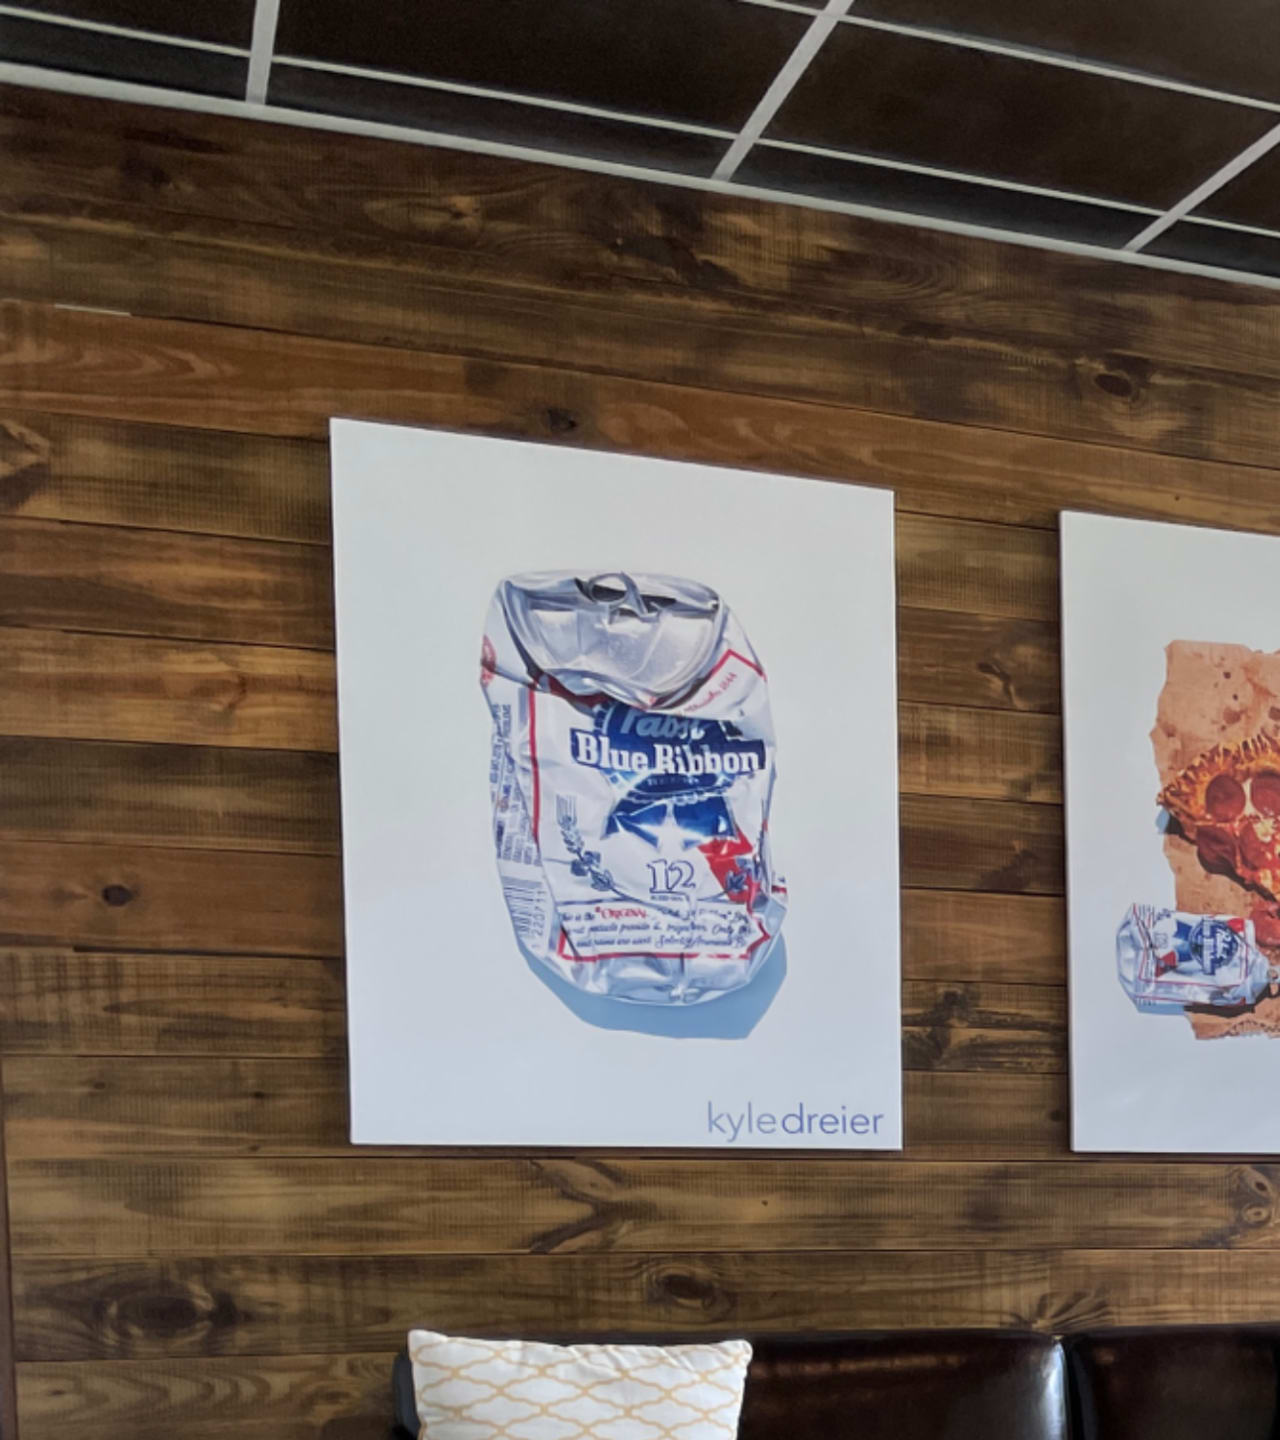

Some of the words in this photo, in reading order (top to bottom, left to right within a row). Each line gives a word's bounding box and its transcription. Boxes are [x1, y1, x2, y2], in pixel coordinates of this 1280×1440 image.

[575, 731, 649, 771] Blue
[653, 743, 760, 775] Ribbon
[646, 859, 696, 894] 12
[708, 1101, 884, 1143] kyledreier
